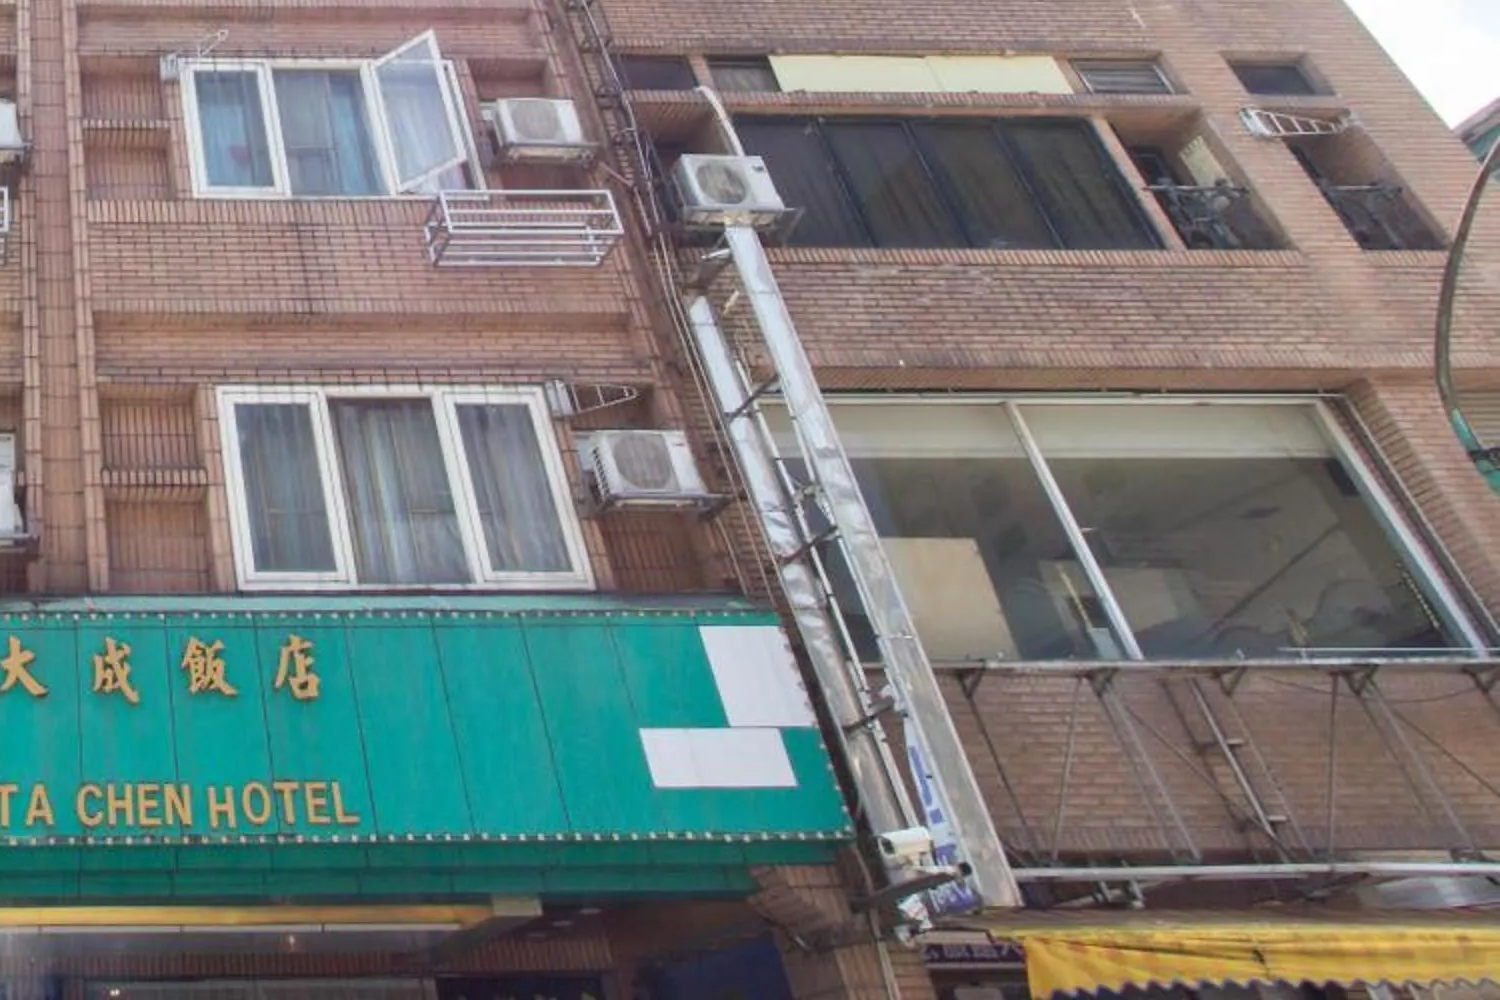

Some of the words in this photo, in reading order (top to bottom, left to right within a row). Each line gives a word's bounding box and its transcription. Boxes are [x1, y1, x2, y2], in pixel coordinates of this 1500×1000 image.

[0, 634, 322, 703] 大成飯店
[77, 783, 192, 828] CHEN
[208, 781, 360, 829] HOTEL
